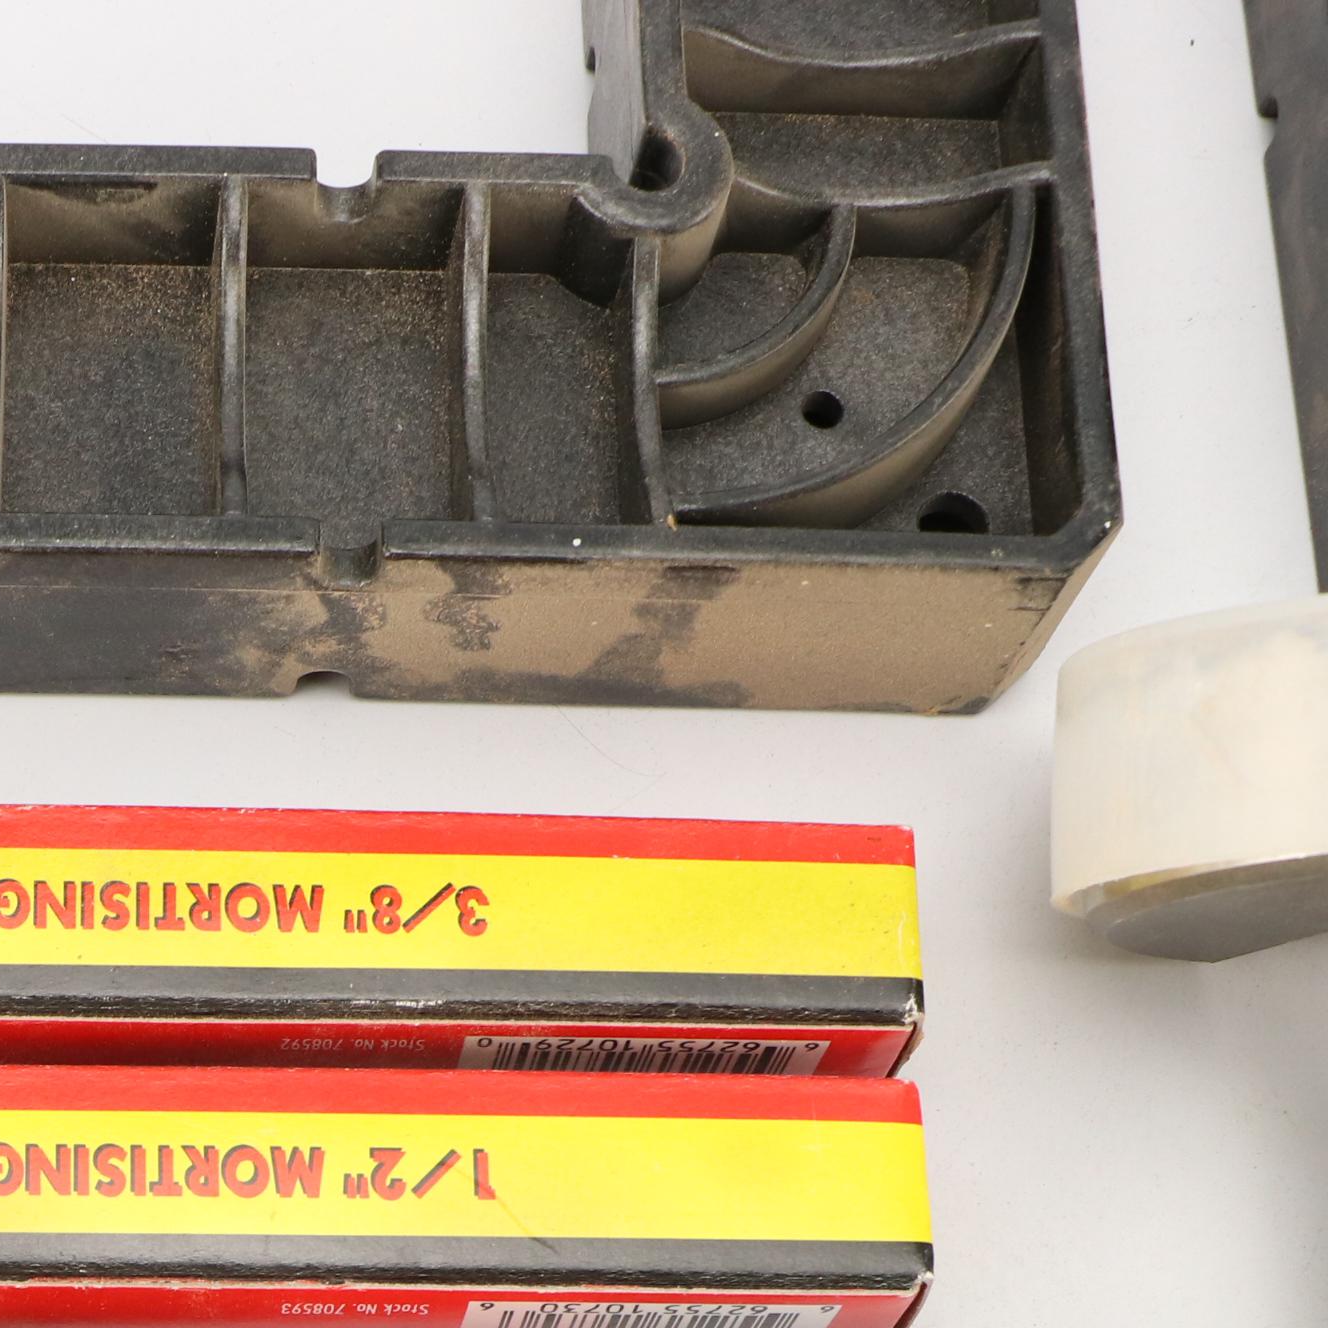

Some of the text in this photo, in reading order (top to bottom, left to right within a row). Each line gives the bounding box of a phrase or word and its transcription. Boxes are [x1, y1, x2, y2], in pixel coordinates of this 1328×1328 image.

[343, 882, 490, 936] 3/8"
[280, 1037, 425, 1050] Stock No. 708592
[478, 1037, 819, 1054] 6 62755 10729 0
[343, 1146, 496, 1201] 1/2"
[281, 1302, 429, 1316] Stock No. 708593
[480, 1302, 834, 1318] 6 62755 10730 6
